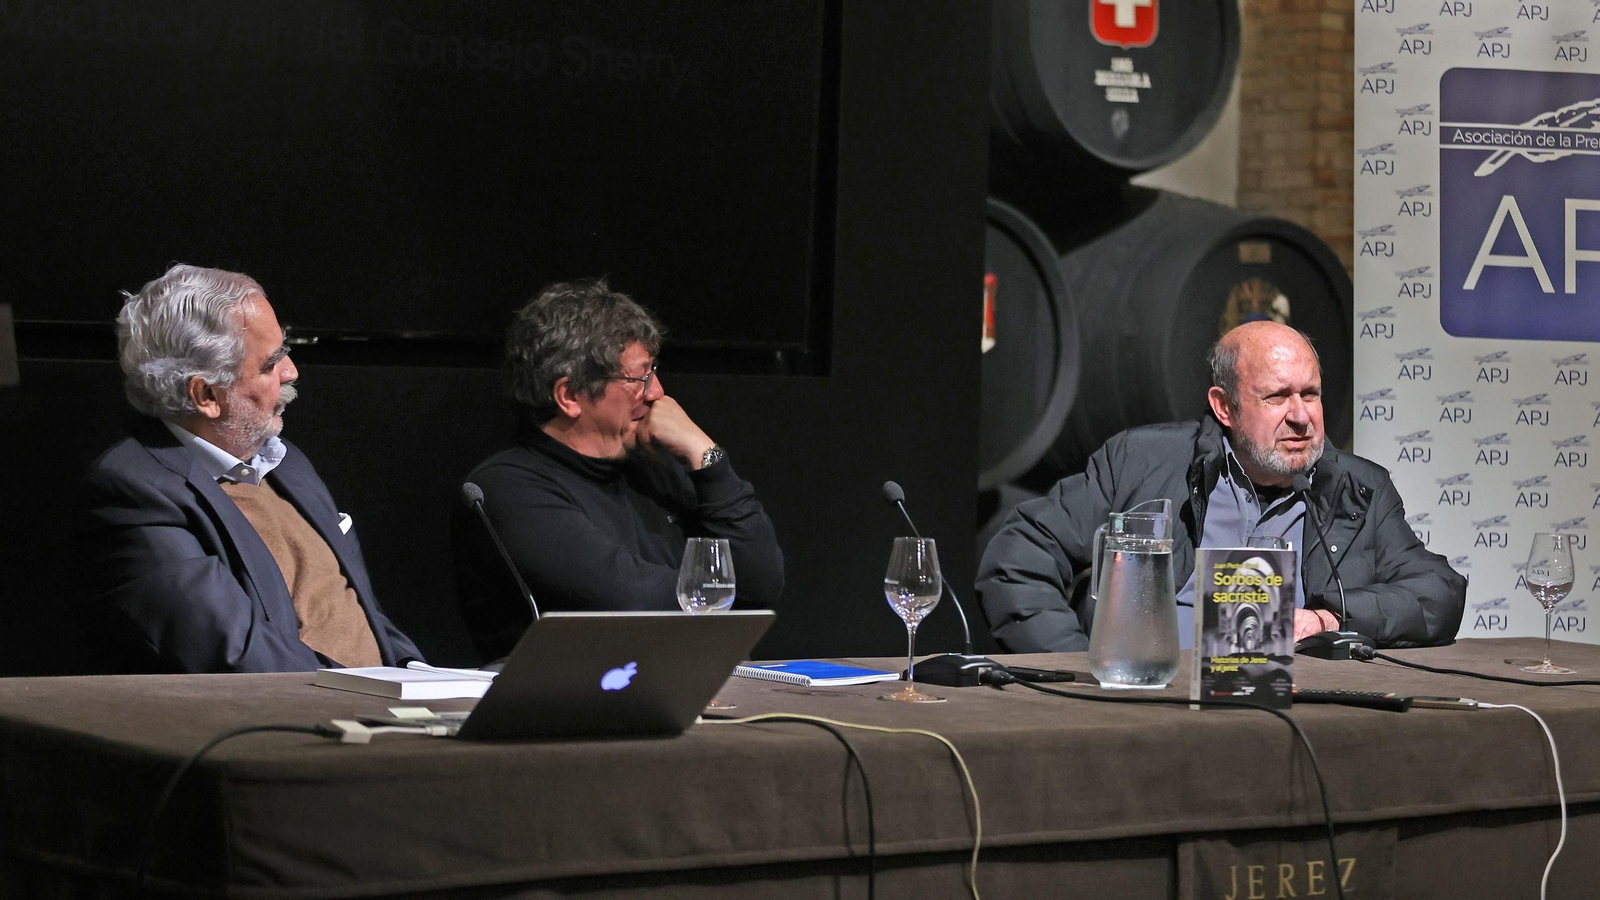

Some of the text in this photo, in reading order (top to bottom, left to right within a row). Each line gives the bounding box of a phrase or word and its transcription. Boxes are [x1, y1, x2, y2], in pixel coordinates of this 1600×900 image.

[1361, 0, 1394, 13] APJ
[1440, 0, 1472, 17] APJ
[1517, 5, 1549, 21] APJ
[377, 17, 549, 79] Consejo
[561, 33, 692, 92] Sherry
[1399, 39, 1432, 55] APJ
[1477, 43, 1510, 58] APJ
[1555, 46, 1588, 62] APJ
[1361, 79, 1394, 94] APJ
[1398, 120, 1432, 136] APJ
[1453, 129, 1533, 146] Asociación
[1536, 133, 1555, 147] de
[1559, 133, 1572, 148] la
[1361, 160, 1394, 175] APJ
[1398, 201, 1432, 217] APJ
[1360, 242, 1394, 257] APJ
[1398, 283, 1432, 298] APJ
[1360, 323, 1394, 339] APJ
[1398, 365, 1432, 380] APJ
[1476, 367, 1509, 383] APJ
[1555, 370, 1587, 386] APJ
[1360, 406, 1394, 421] APJ
[1439, 407, 1472, 423] APJ
[1516, 410, 1549, 426] APJ
[1397, 447, 1431, 463] APJ
[1476, 449, 1508, 466] APJ
[1554, 452, 1587, 468] APJ
[1438, 490, 1470, 506] APJ
[1515, 492, 1548, 508] APJ
[1474, 532, 1508, 548] APJ
[1213, 571, 1284, 586] Sorbos de
[1212, 588, 1270, 603] sacristía
[1474, 615, 1507, 631] APJ
[1553, 617, 1586, 633] APJ
[1225, 857, 1357, 900] JEREZ
